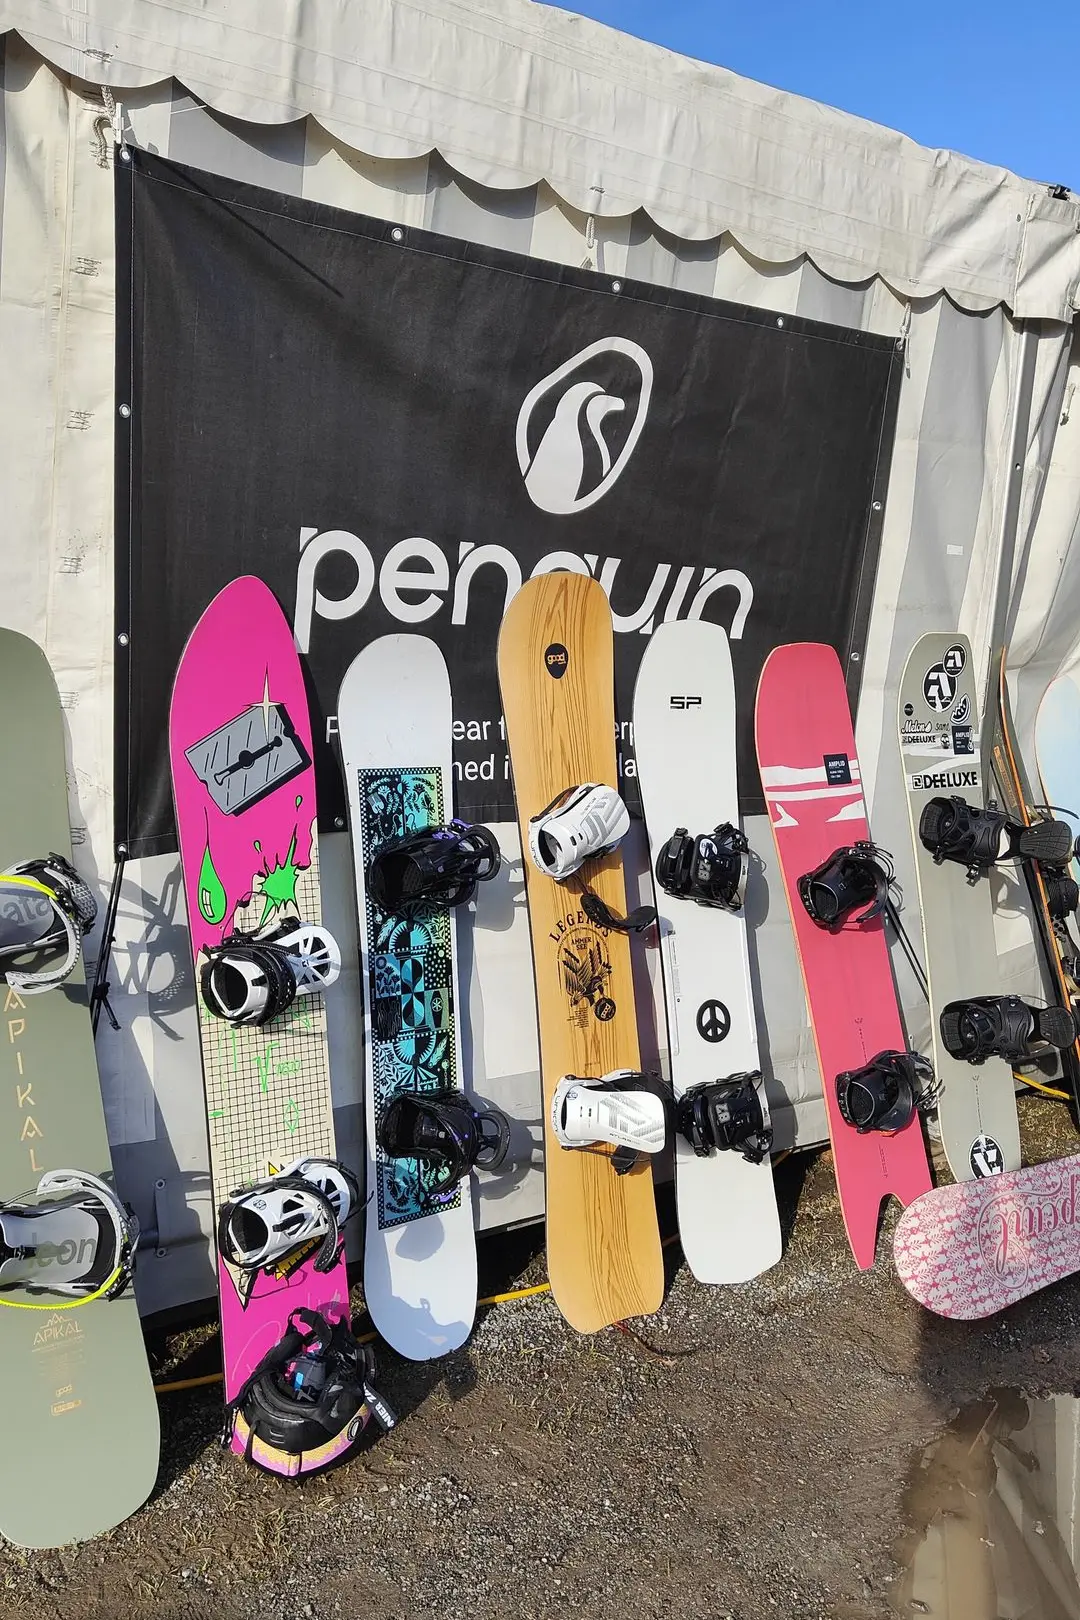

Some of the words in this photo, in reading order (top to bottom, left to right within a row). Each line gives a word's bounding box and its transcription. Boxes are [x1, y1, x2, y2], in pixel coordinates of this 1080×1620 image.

[670, 696, 702, 709] SP
[908, 735, 936, 743] DEELUXE
[923, 772, 978, 789] DEELUXE
[549, 911, 613, 943] LEGES
[4, 988, 44, 1172] APIKAL
[33, 1321, 83, 1345] APIKAL
